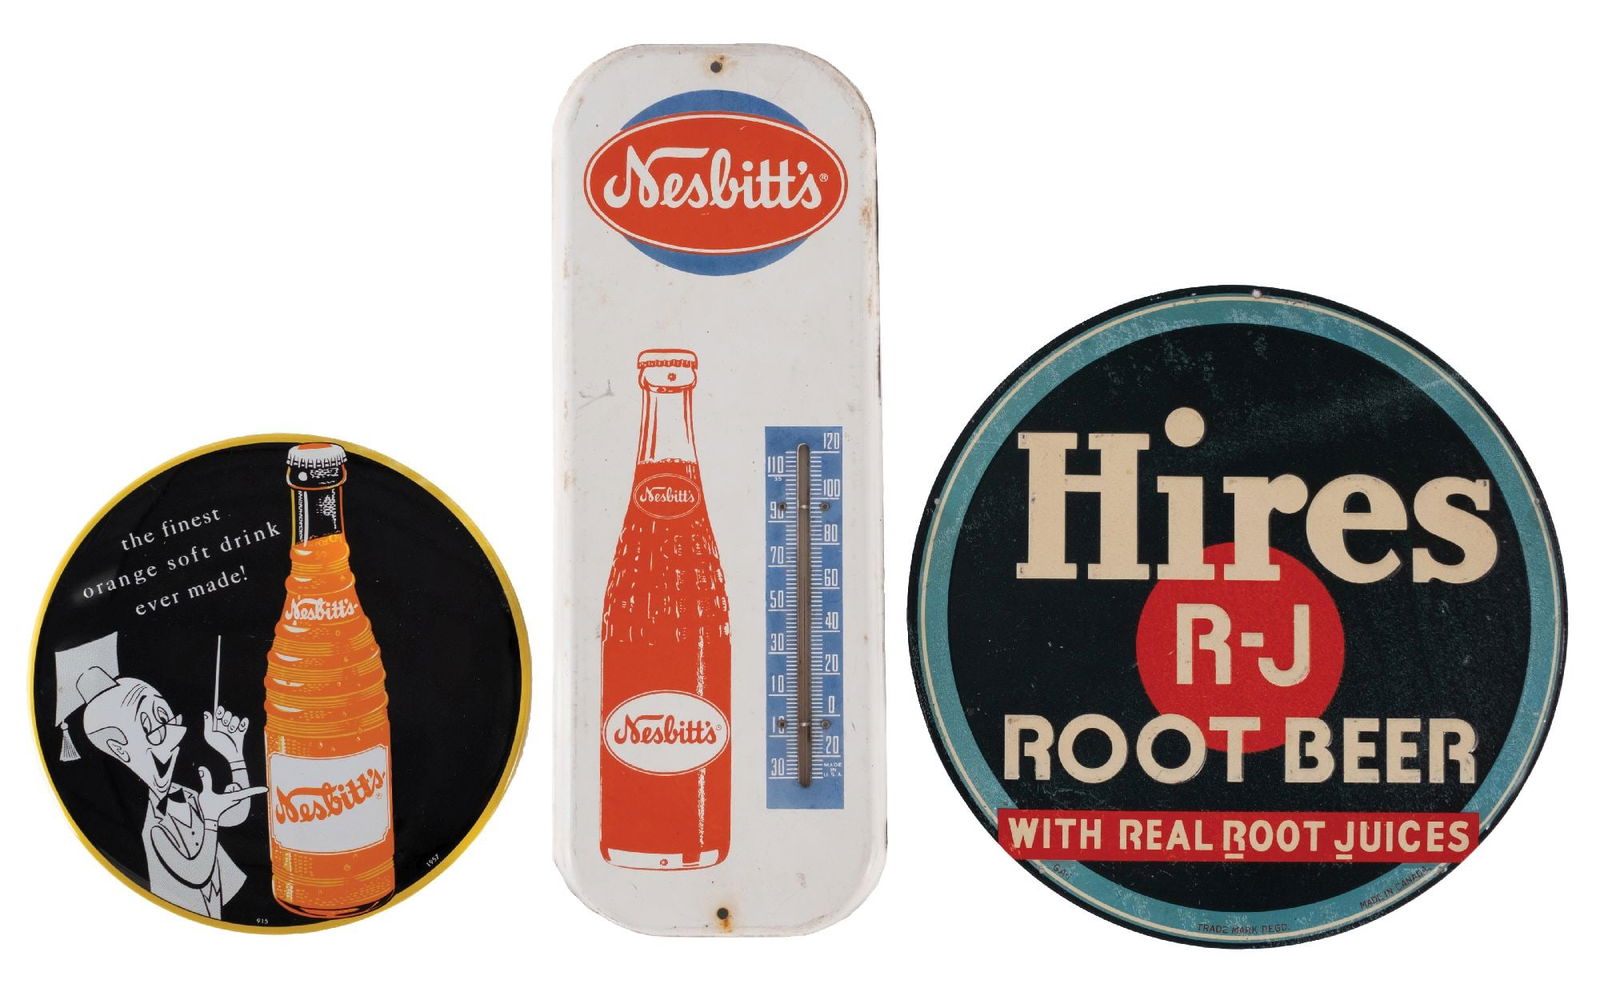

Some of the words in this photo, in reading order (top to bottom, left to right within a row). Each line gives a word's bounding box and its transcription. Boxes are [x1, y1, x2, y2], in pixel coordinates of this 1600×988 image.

[823, 432, 840, 450] 120
[767, 456, 784, 474] 110
[639, 486, 696, 503] Nesbitt's
[823, 479, 841, 497] 100
[1015, 406, 1499, 584] Hires
[121, 533, 155, 551] the
[162, 509, 221, 538] finest
[824, 524, 838, 542] 80
[83, 565, 158, 599] orange
[167, 546, 211, 571] soft
[219, 521, 281, 553] drink
[770, 546, 784, 564] 70
[824, 568, 839, 587] 60
[135, 592, 180, 616] ever
[187, 565, 249, 599] made!
[769, 590, 784, 608] 50
[825, 611, 839, 630] 40
[770, 633, 785, 651] 30
[1176, 603, 1311, 687] R-J
[825, 654, 839, 672] 20
[771, 675, 785, 693] 10
[828, 695, 836, 714] 0
[825, 736, 839, 754] 20
[1003, 714, 1261, 784] ROOT
[1284, 716, 1478, 784] BEER
[771, 758, 785, 776] 30
[1008, 818, 1102, 849] WITH
[1119, 819, 1214, 851] REAL
[1223, 819, 1326, 860] ROOT
[1334, 820, 1470, 860] JUICES
